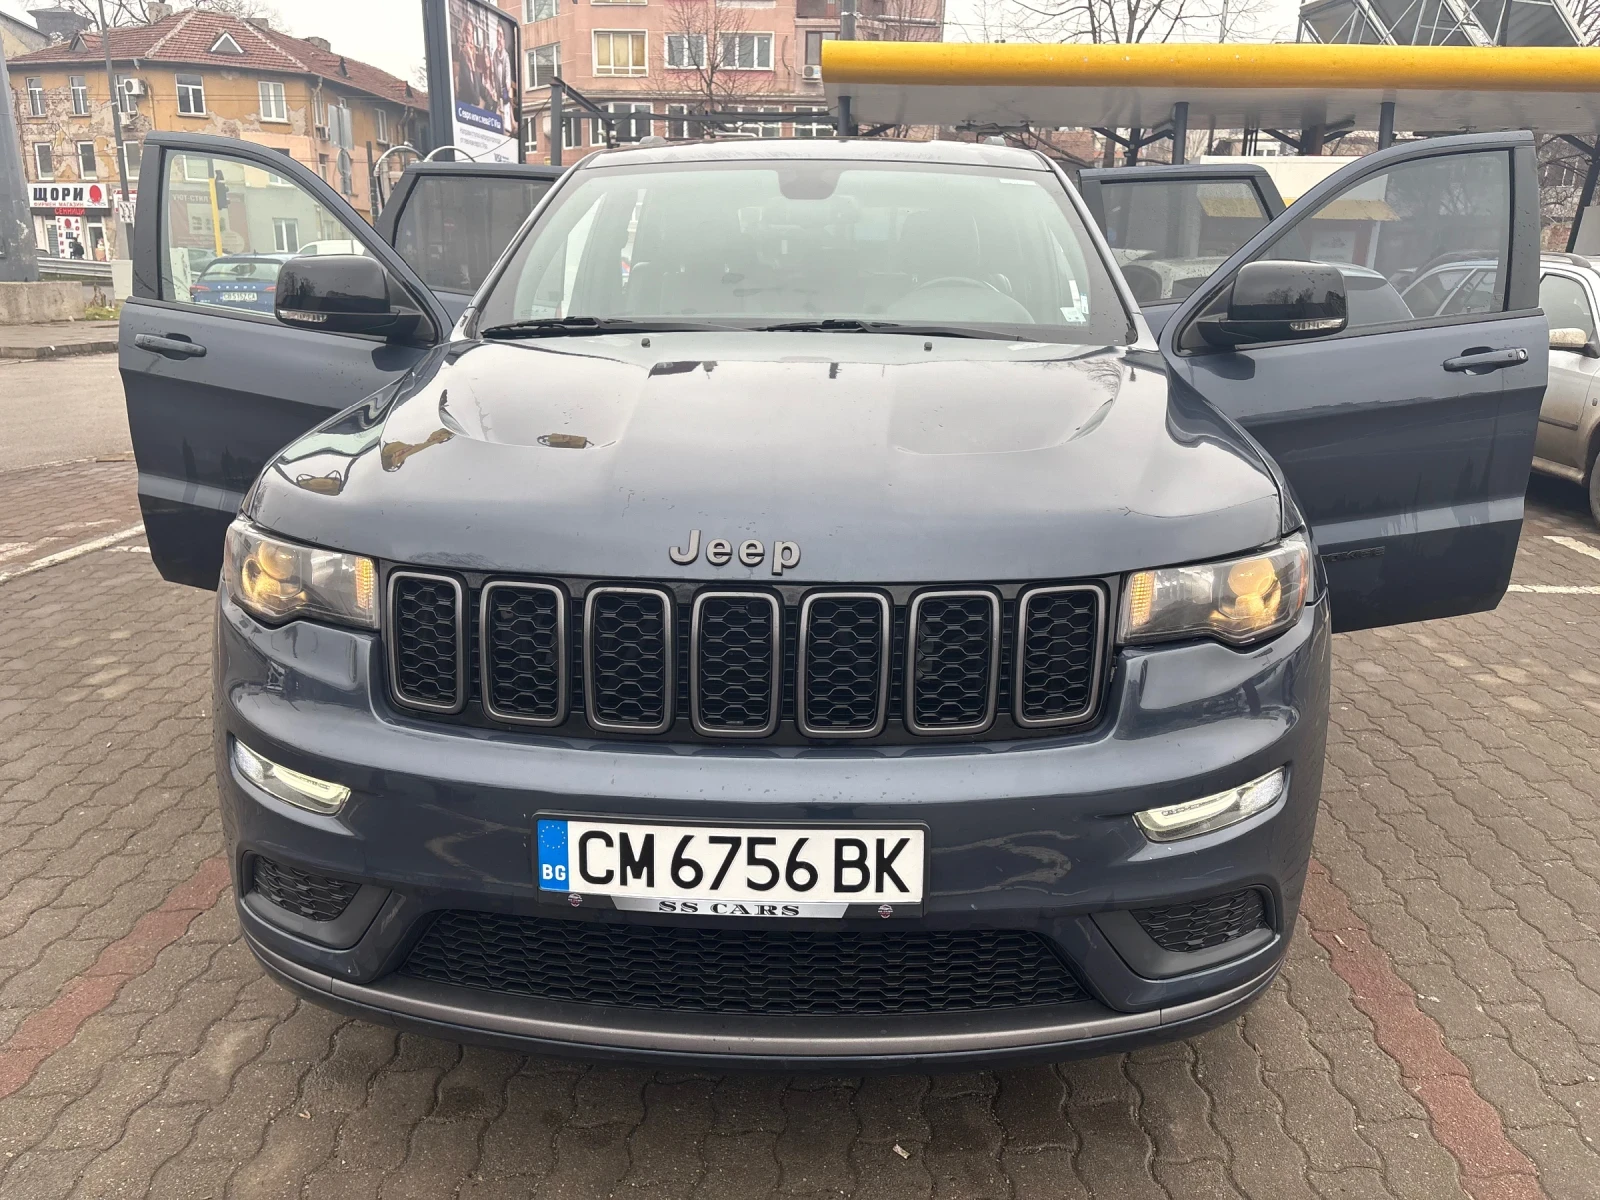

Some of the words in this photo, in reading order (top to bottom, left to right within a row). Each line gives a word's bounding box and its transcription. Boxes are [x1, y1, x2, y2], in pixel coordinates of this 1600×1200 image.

[33, 187, 84, 202] ЩОРИ
[669, 529, 801, 576] Jeep
[578, 830, 655, 888] CM
[670, 834, 819, 892] 6756
[833, 837, 911, 893] BK
[542, 865, 566, 881] BG
[658, 900, 699, 913] SS
[709, 902, 800, 916] CARS
